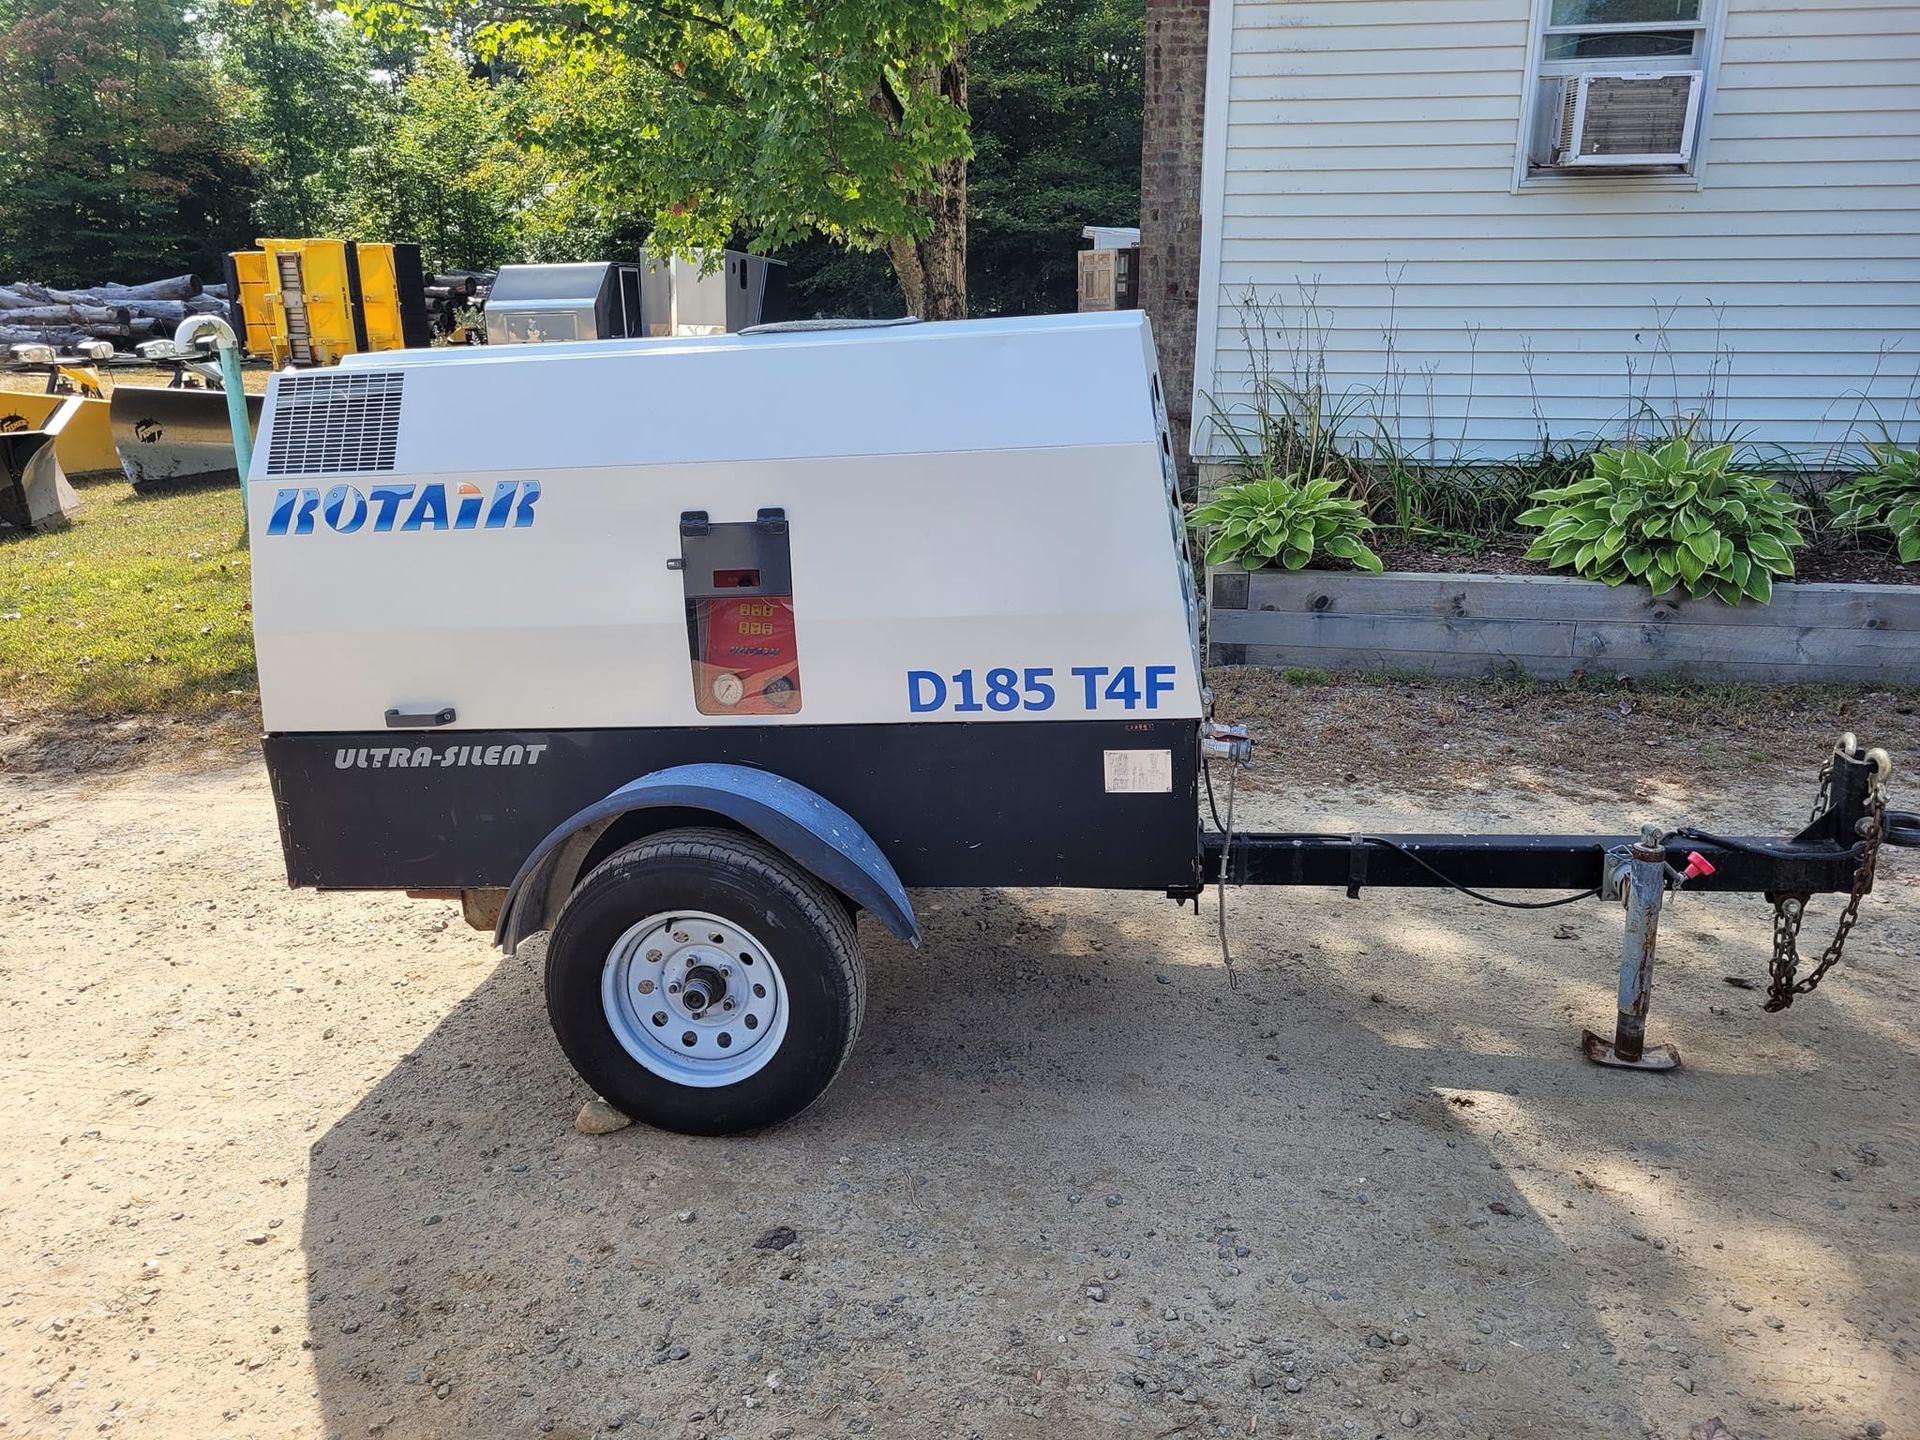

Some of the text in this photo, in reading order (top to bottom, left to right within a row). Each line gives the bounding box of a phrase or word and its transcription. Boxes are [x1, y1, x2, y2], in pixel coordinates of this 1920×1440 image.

[907, 665, 1176, 713] D185 T4F
[334, 744, 548, 769] ULTRA-SILENT
